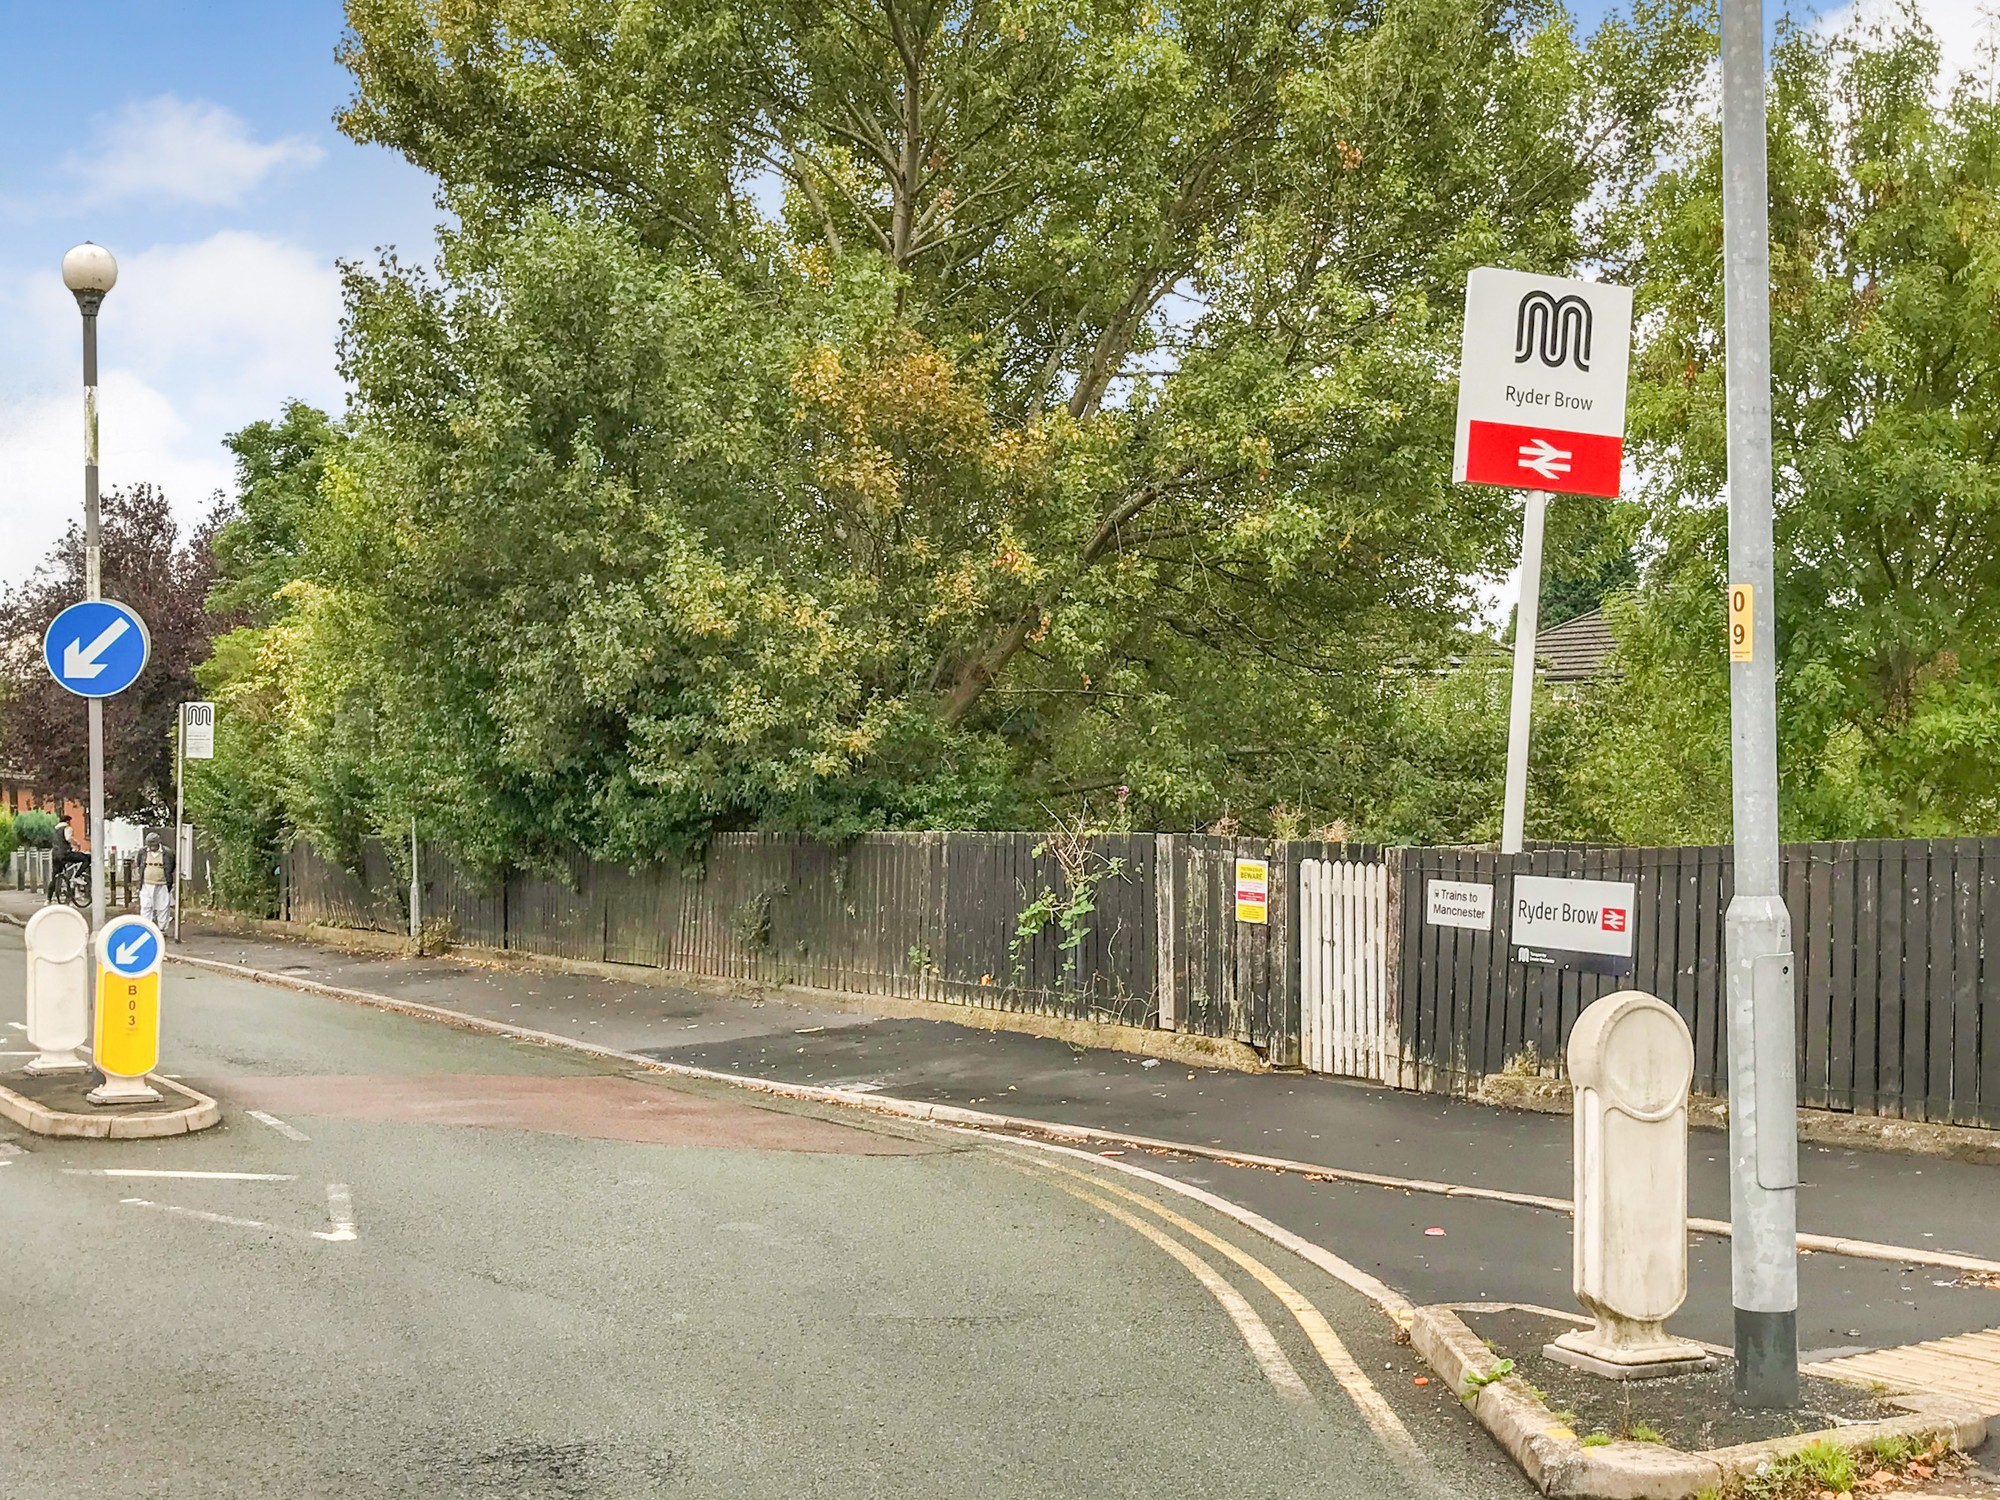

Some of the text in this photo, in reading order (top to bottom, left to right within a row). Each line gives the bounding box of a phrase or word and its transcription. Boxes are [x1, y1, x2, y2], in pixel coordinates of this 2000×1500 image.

[1506, 386, 1593, 411] Ryder Brow
[1240, 872, 1263, 880] BEWARE
[1441, 889, 1478, 903] Trains to
[1433, 904, 1486, 919] Manchester
[1518, 899, 1598, 925] Ryder Brow
